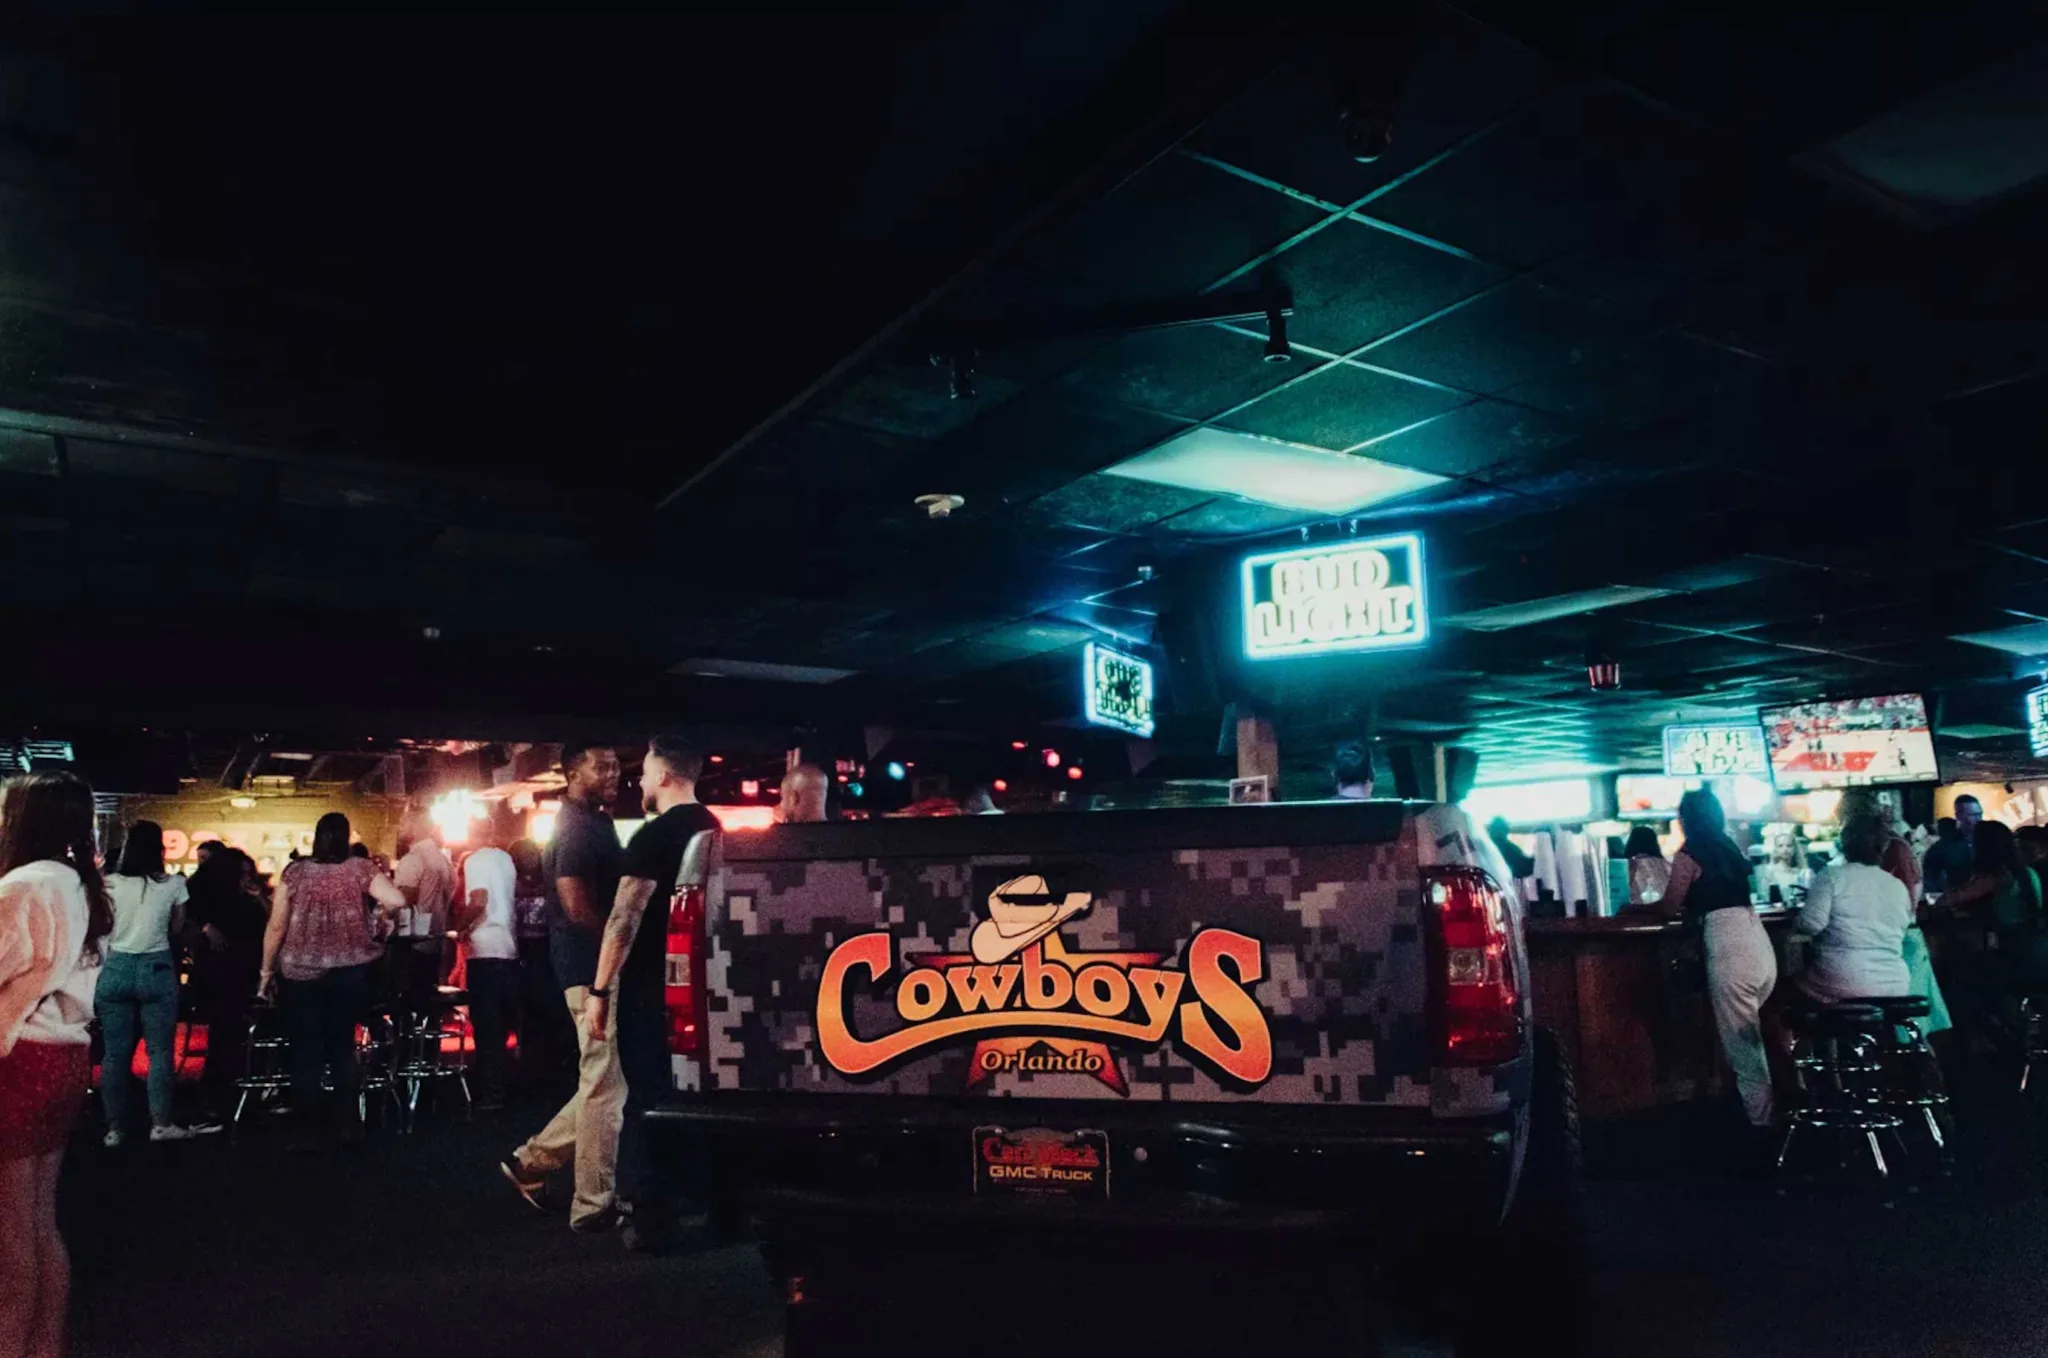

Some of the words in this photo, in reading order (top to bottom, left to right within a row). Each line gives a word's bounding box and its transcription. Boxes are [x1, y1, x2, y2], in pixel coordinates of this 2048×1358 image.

[1272, 550, 1388, 598] BUD
[1253, 587, 1415, 646] LIGHT
[980, 1049, 1102, 1072] Orlando
[989, 1165, 1037, 1178] GMC
